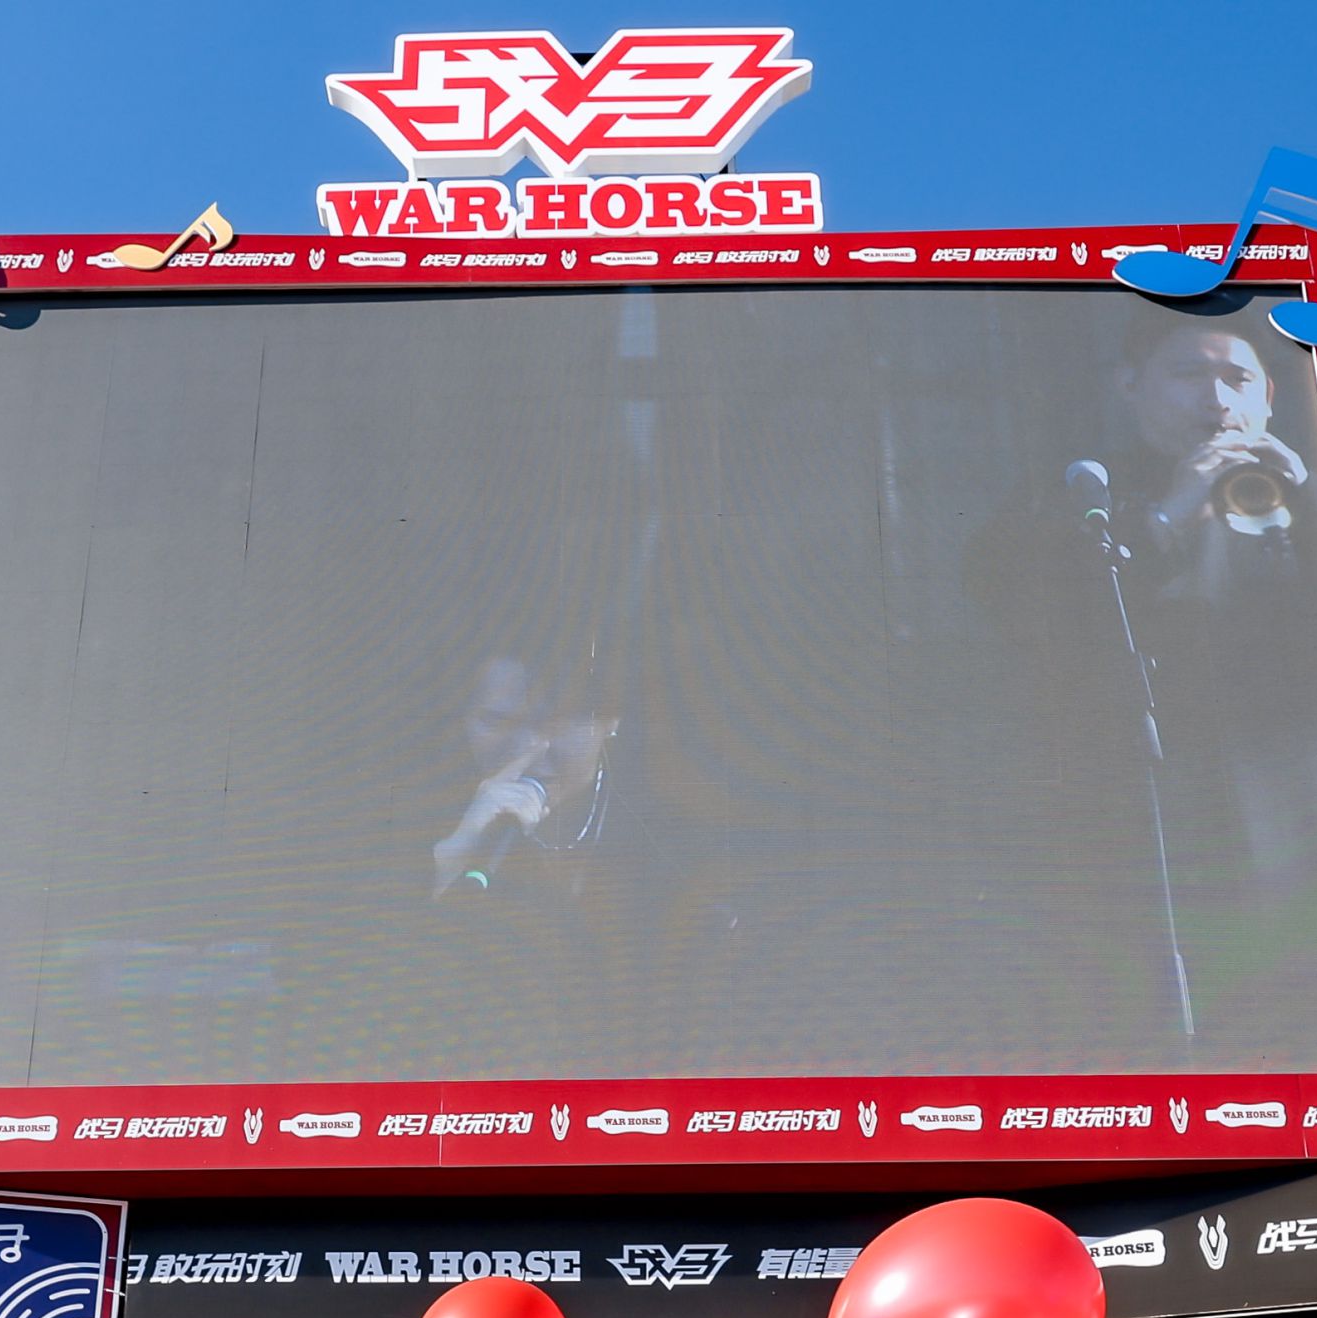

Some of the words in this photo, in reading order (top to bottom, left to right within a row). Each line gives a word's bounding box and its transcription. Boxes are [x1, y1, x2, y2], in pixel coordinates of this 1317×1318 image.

[326, 187, 511, 236] WAR
[525, 180, 815, 231] HORSE
[420, 254, 461, 266] 战马
[462, 254, 547, 266] 敢玩时刻
[673, 252, 713, 264] 战马
[715, 250, 799, 263] 敢玩时刻
[931, 249, 971, 261] 战马
[973, 247, 1057, 261] 敢玩时刻
[297, 1121, 319, 1130] WAR
[319, 1120, 355, 1130] HORSE
[378, 1115, 428, 1135] 战马
[429, 1112, 533, 1135] 敢玩时刻
[687, 1111, 736, 1132] 战马
[738, 1109, 840, 1131] 敢玩时刻
[1001, 1108, 1048, 1128] 战马
[1051, 1105, 1152, 1128] 敢玩时刻
[1222, 1111, 1245, 1120] WAR
[1245, 1110, 1280, 1120] HORSE
[74, 1118, 124, 1139] 战马
[124, 1116, 227, 1138] 敢玩时刻
[1100, 1240, 1155, 1258] HORSE
[149, 1251, 302, 1284] 敢玩时刻
[325, 1252, 421, 1283] WAR
[428, 1249, 581, 1284] HORSE
[756, 1247, 864, 1281] 有能量
